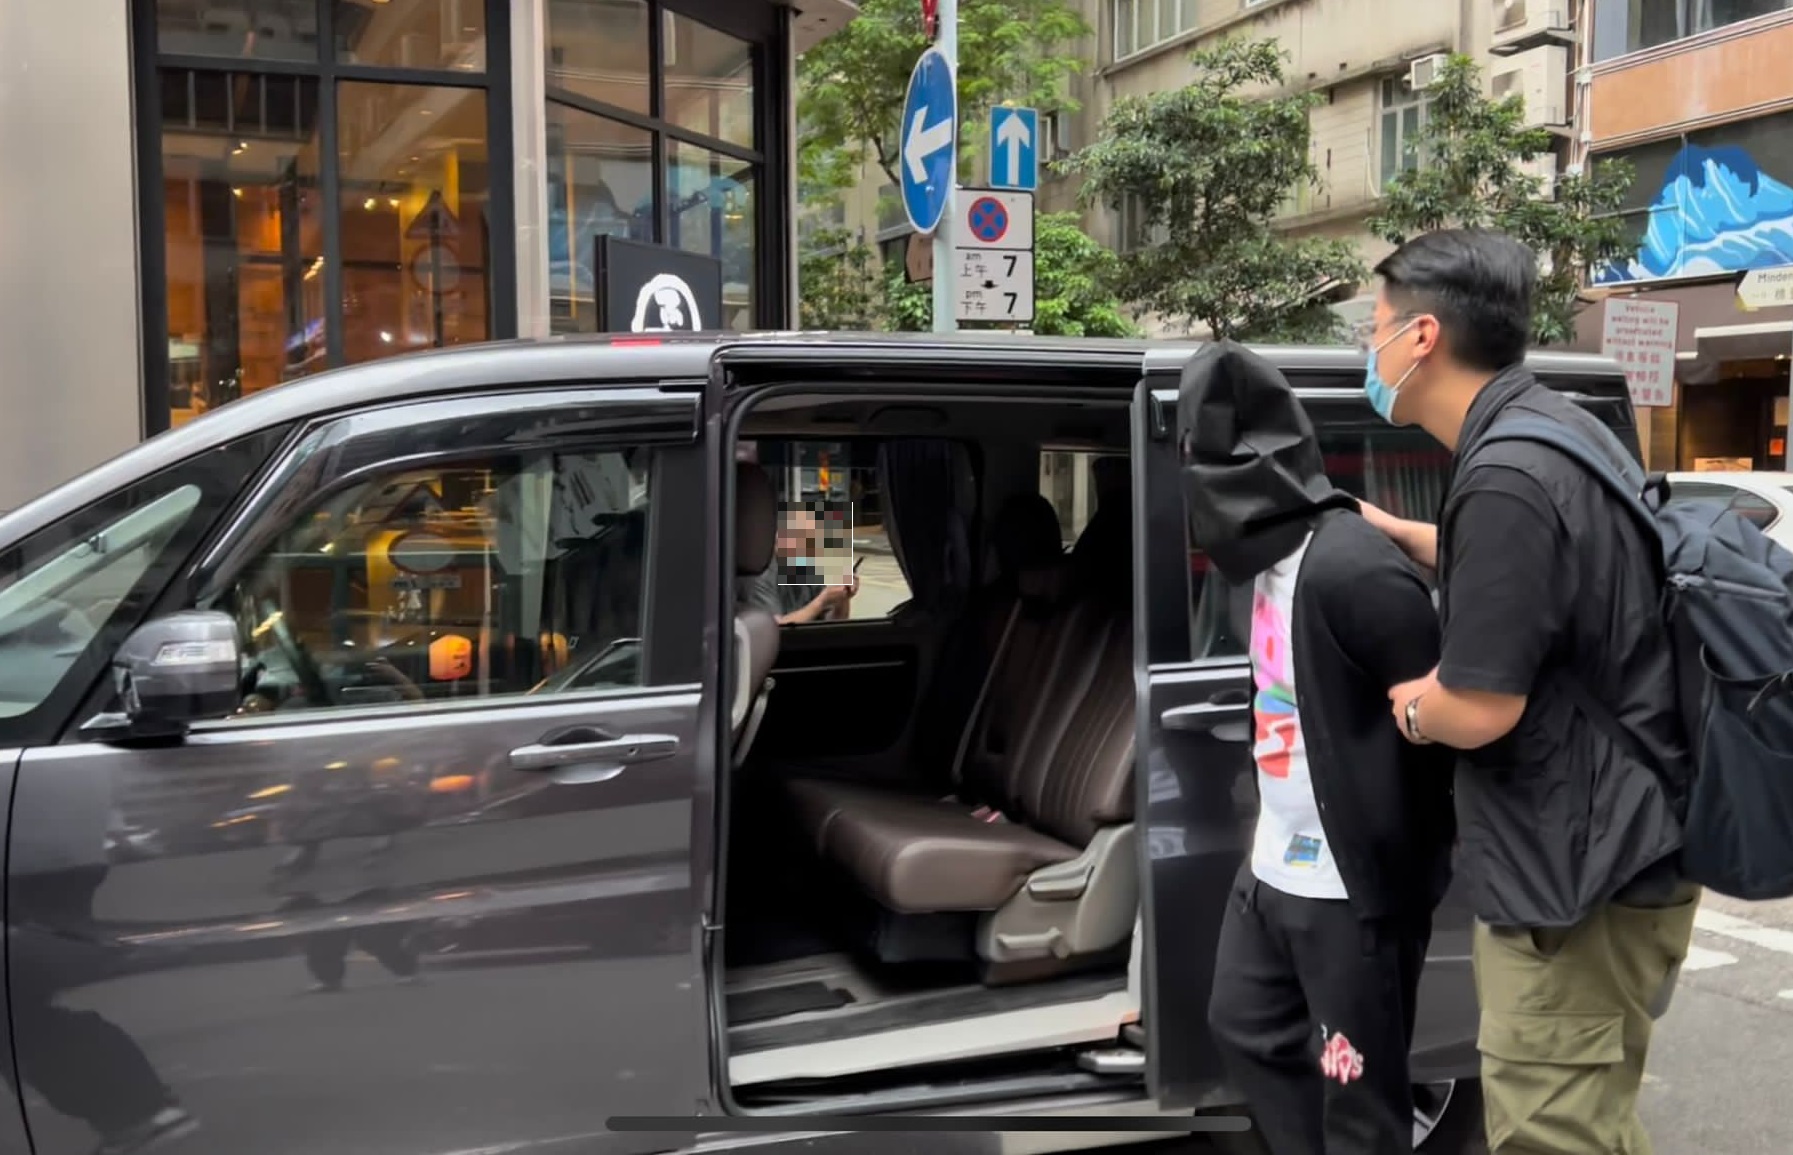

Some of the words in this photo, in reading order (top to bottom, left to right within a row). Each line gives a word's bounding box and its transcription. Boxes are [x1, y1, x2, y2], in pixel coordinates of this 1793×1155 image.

[960, 263, 987, 277] 上午
[1003, 255, 1018, 278] 7
[960, 300, 987, 315] 下午
[1004, 292, 1018, 314] 7
[965, 291, 982, 299] pm
